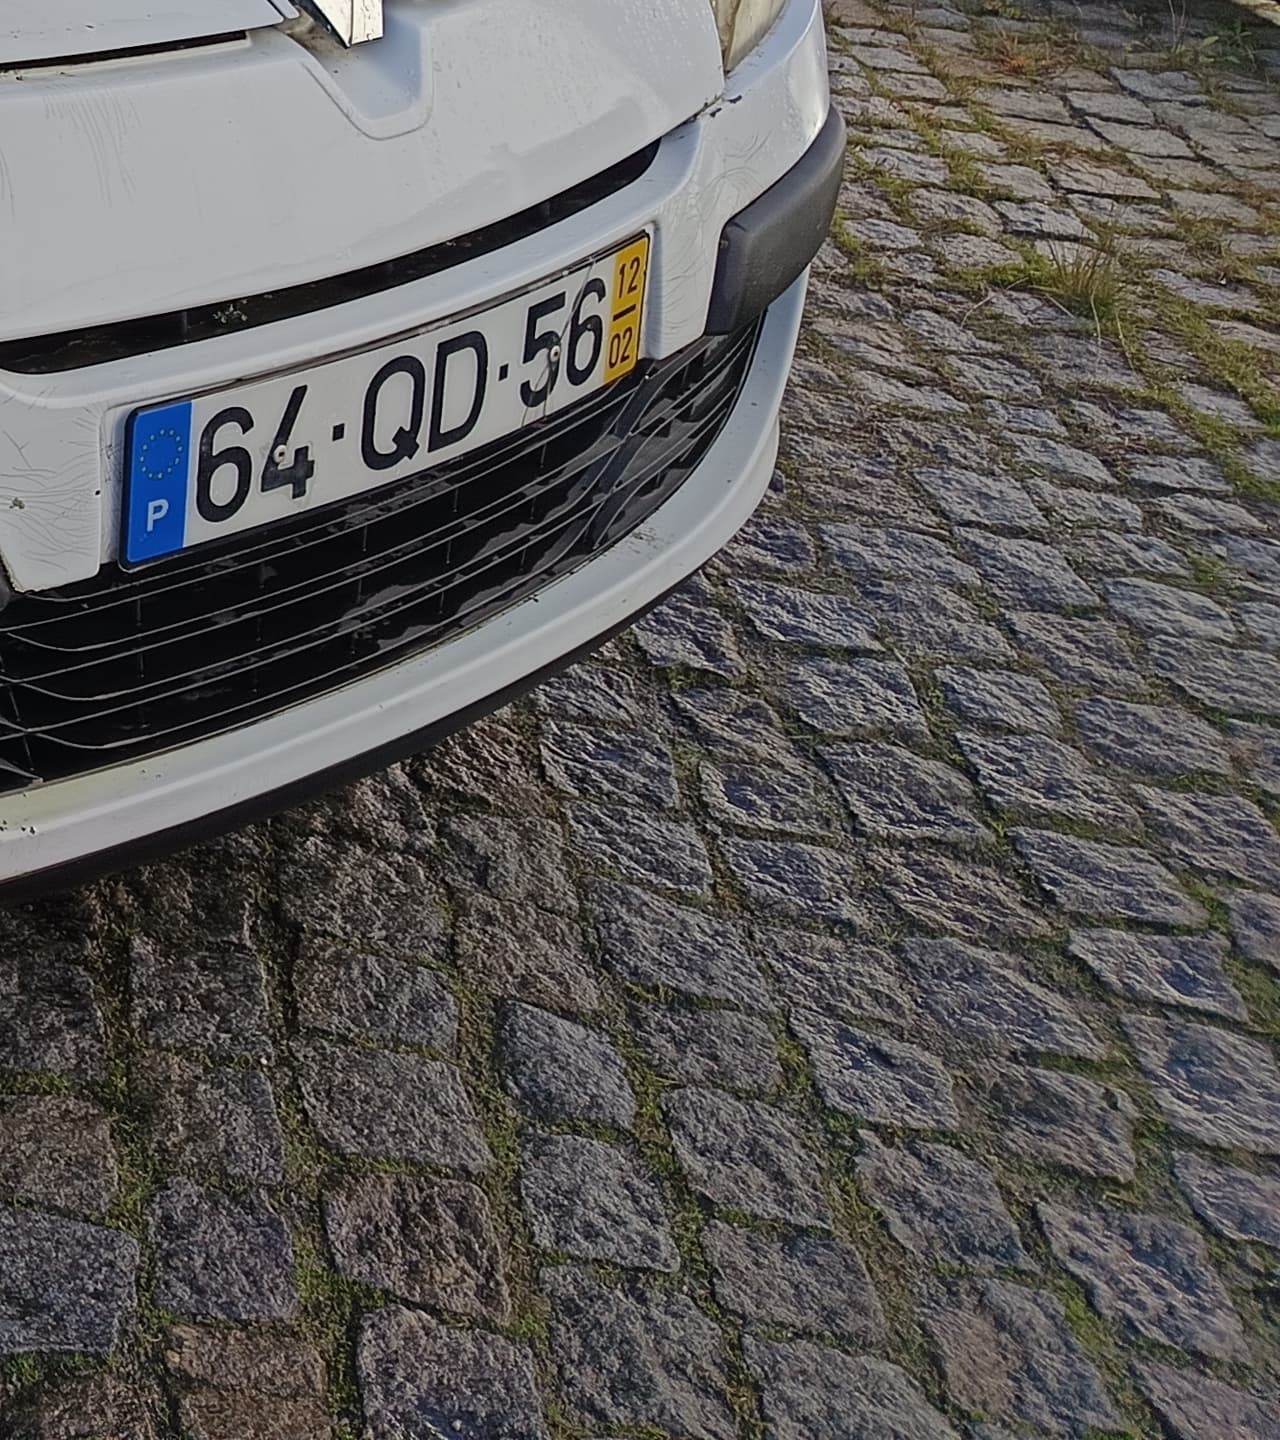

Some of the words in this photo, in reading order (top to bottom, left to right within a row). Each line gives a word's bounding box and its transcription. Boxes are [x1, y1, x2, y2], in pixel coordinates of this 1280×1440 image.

[618, 256, 641, 296] 12
[608, 328, 632, 368] 02
[146, 499, 170, 532] P
